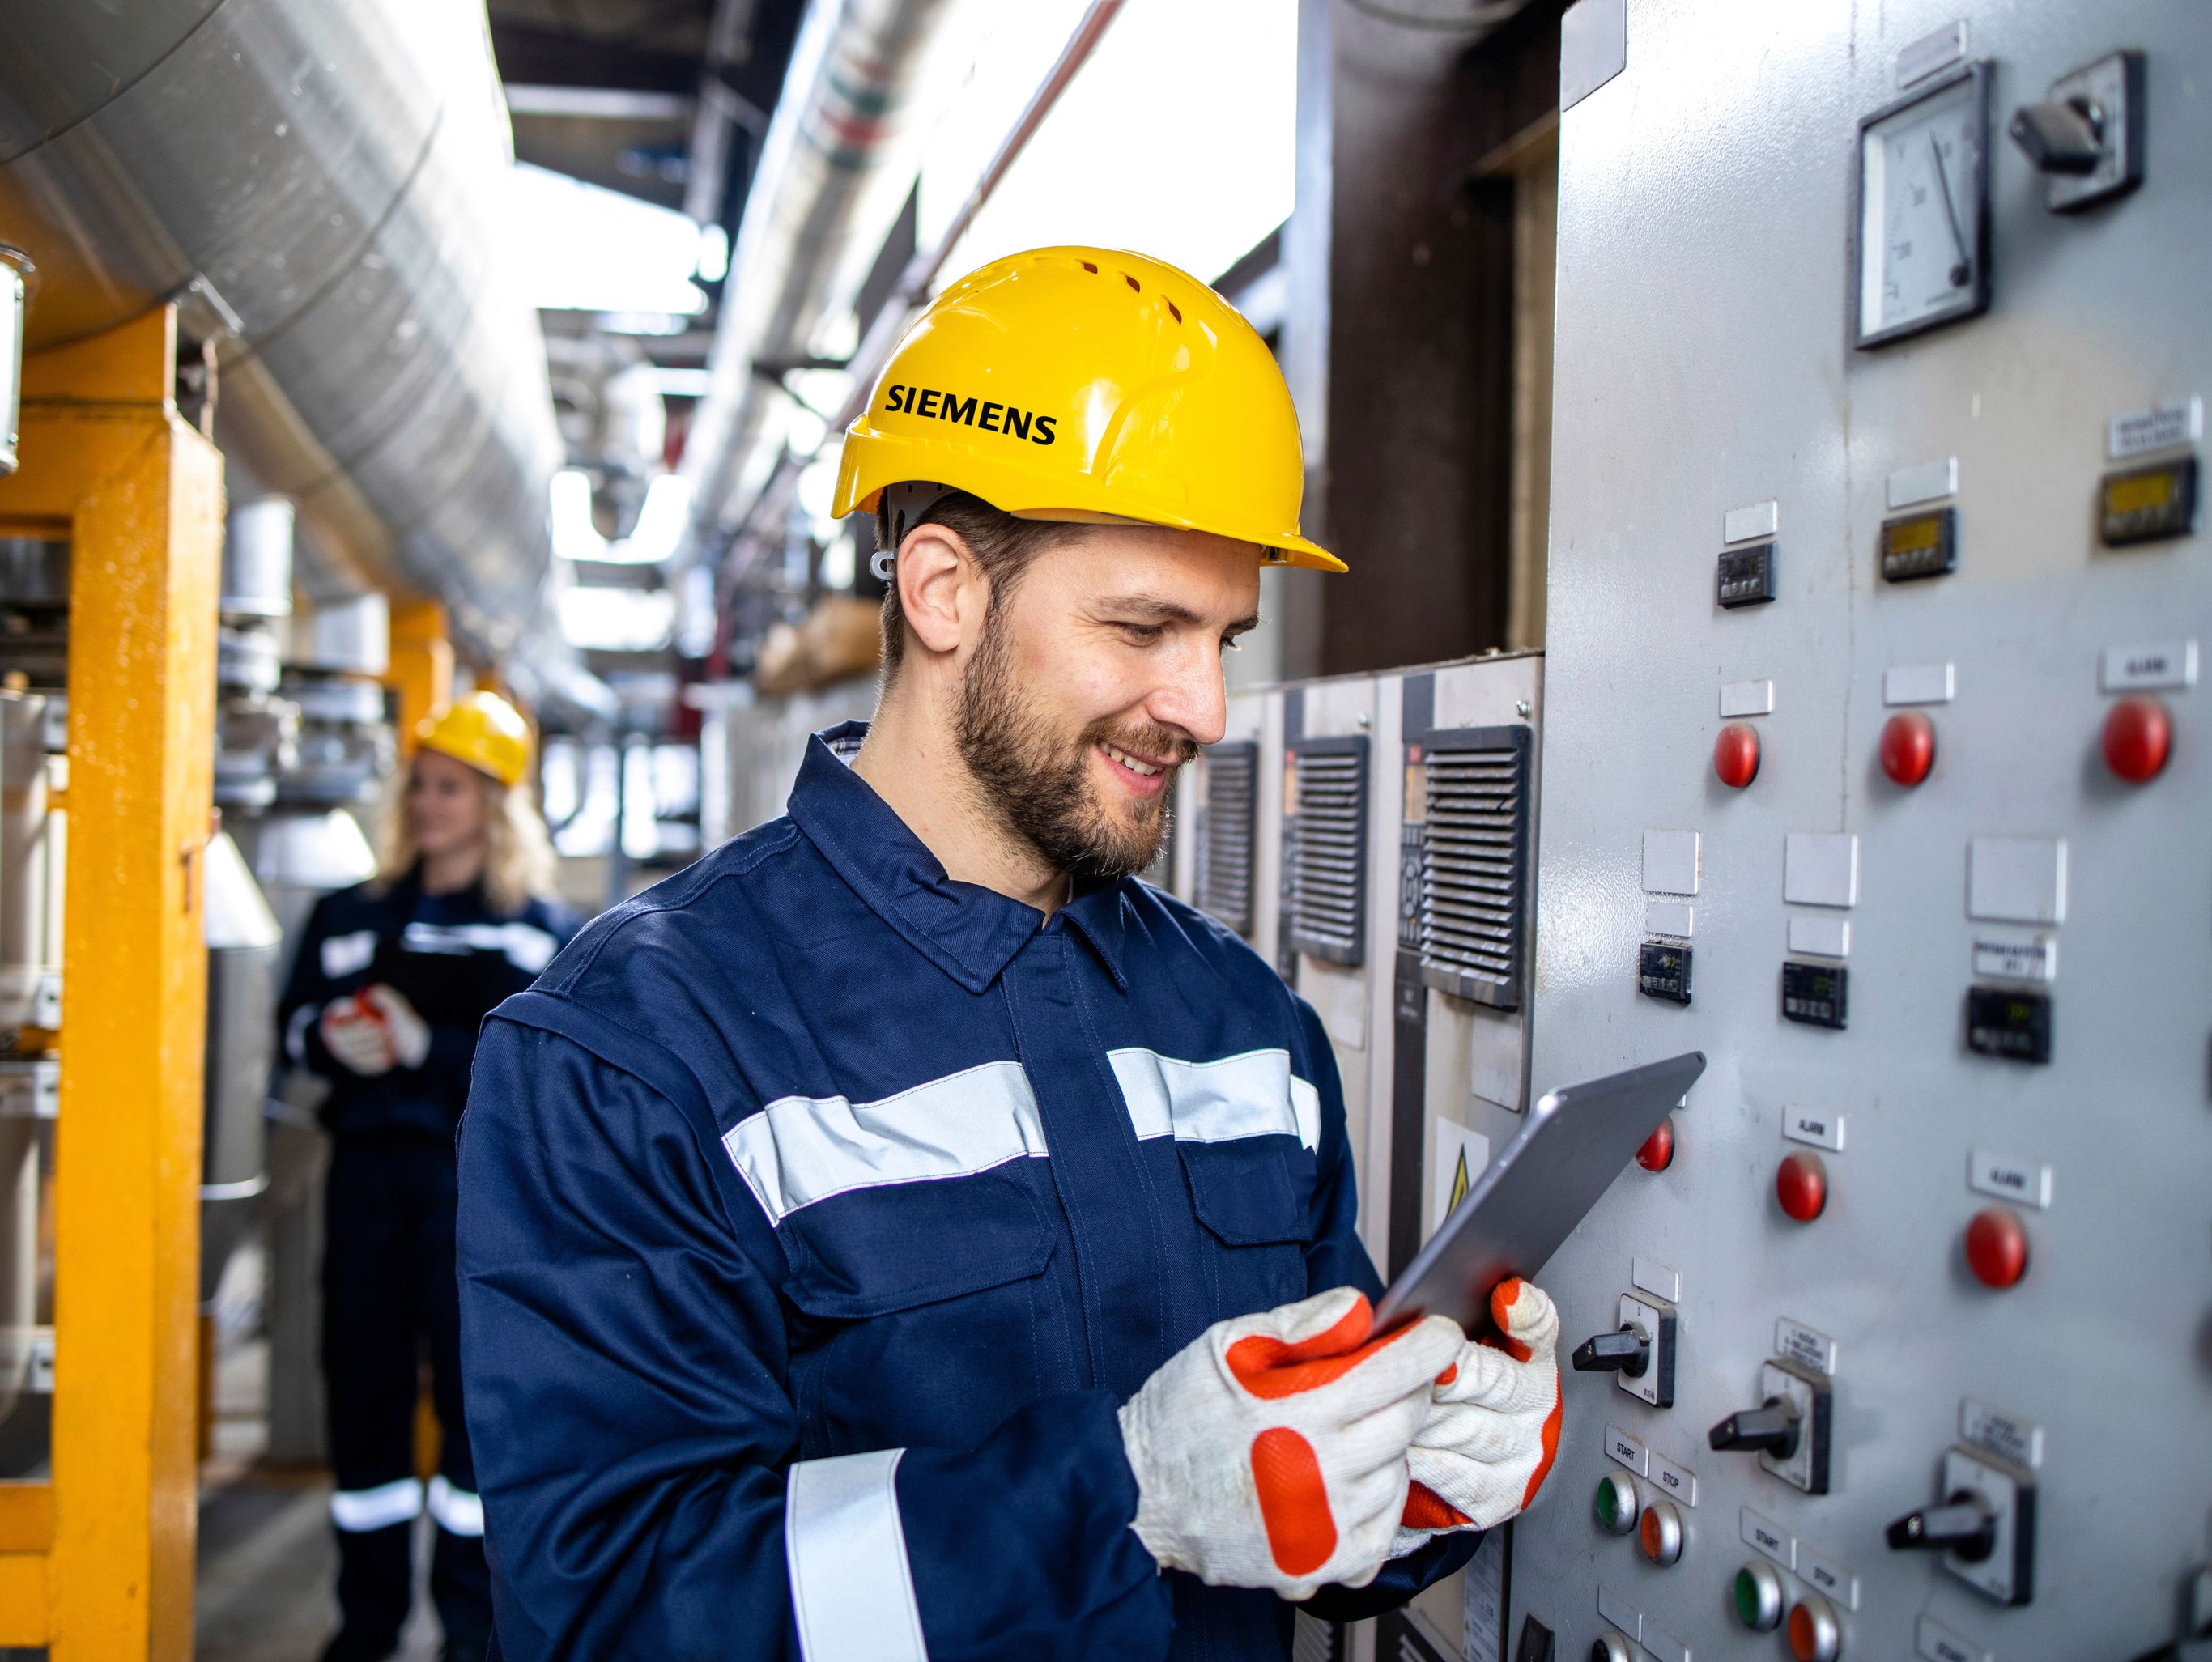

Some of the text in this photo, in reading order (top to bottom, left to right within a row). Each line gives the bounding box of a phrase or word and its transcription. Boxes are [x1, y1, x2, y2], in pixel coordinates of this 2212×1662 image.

[885, 385, 1057, 445] SIEMENS
[1799, 1119, 1825, 1136] ALARM
[1617, 1442, 1635, 1460] START
[1662, 1471, 1679, 1488] STOP
[1755, 1528, 1779, 1550] START
[1814, 1566, 1836, 1587] STOP
